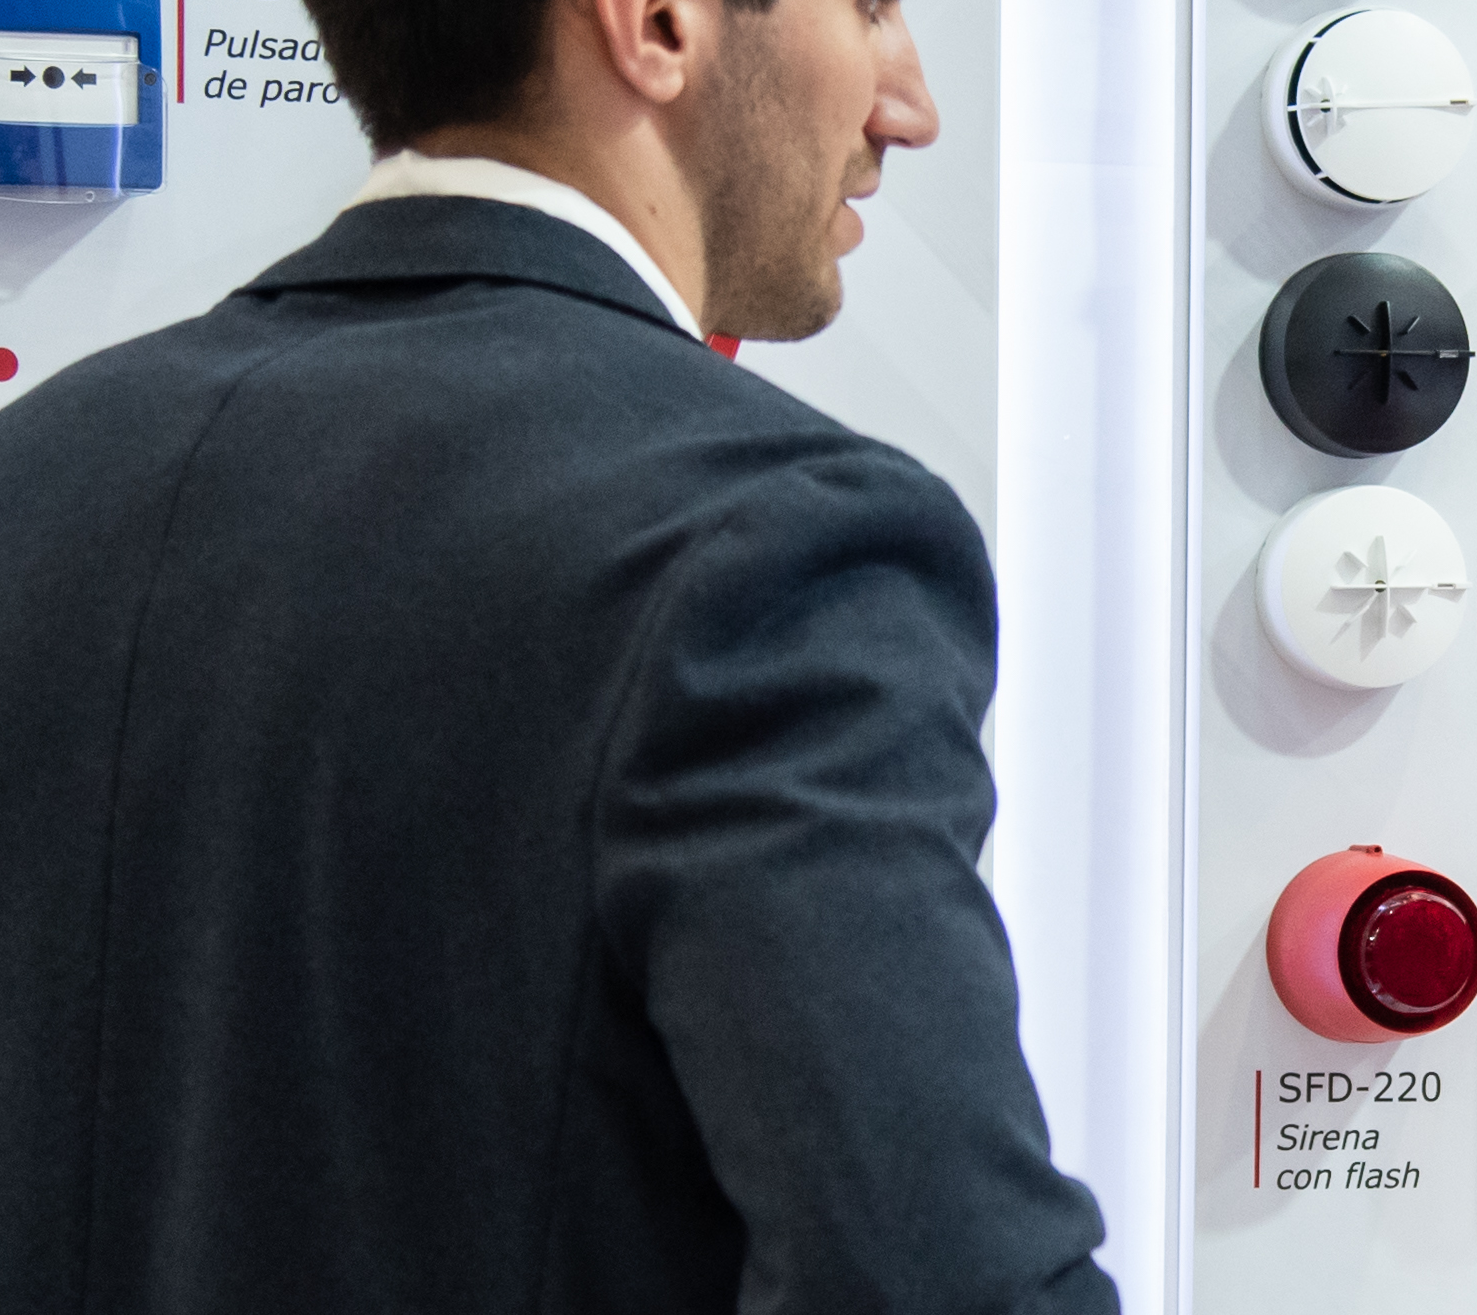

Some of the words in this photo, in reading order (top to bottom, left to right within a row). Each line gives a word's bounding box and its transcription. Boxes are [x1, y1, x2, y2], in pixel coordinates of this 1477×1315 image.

[204, 29, 324, 61] Pulsad
[204, 70, 247, 100] de
[260, 79, 340, 108] paro
[1278, 1070, 1442, 1104] SFD-220
[1276, 1122, 1380, 1152] Sirena
[1275, 1168, 1333, 1191] con
[1345, 1160, 1421, 1190] flash
